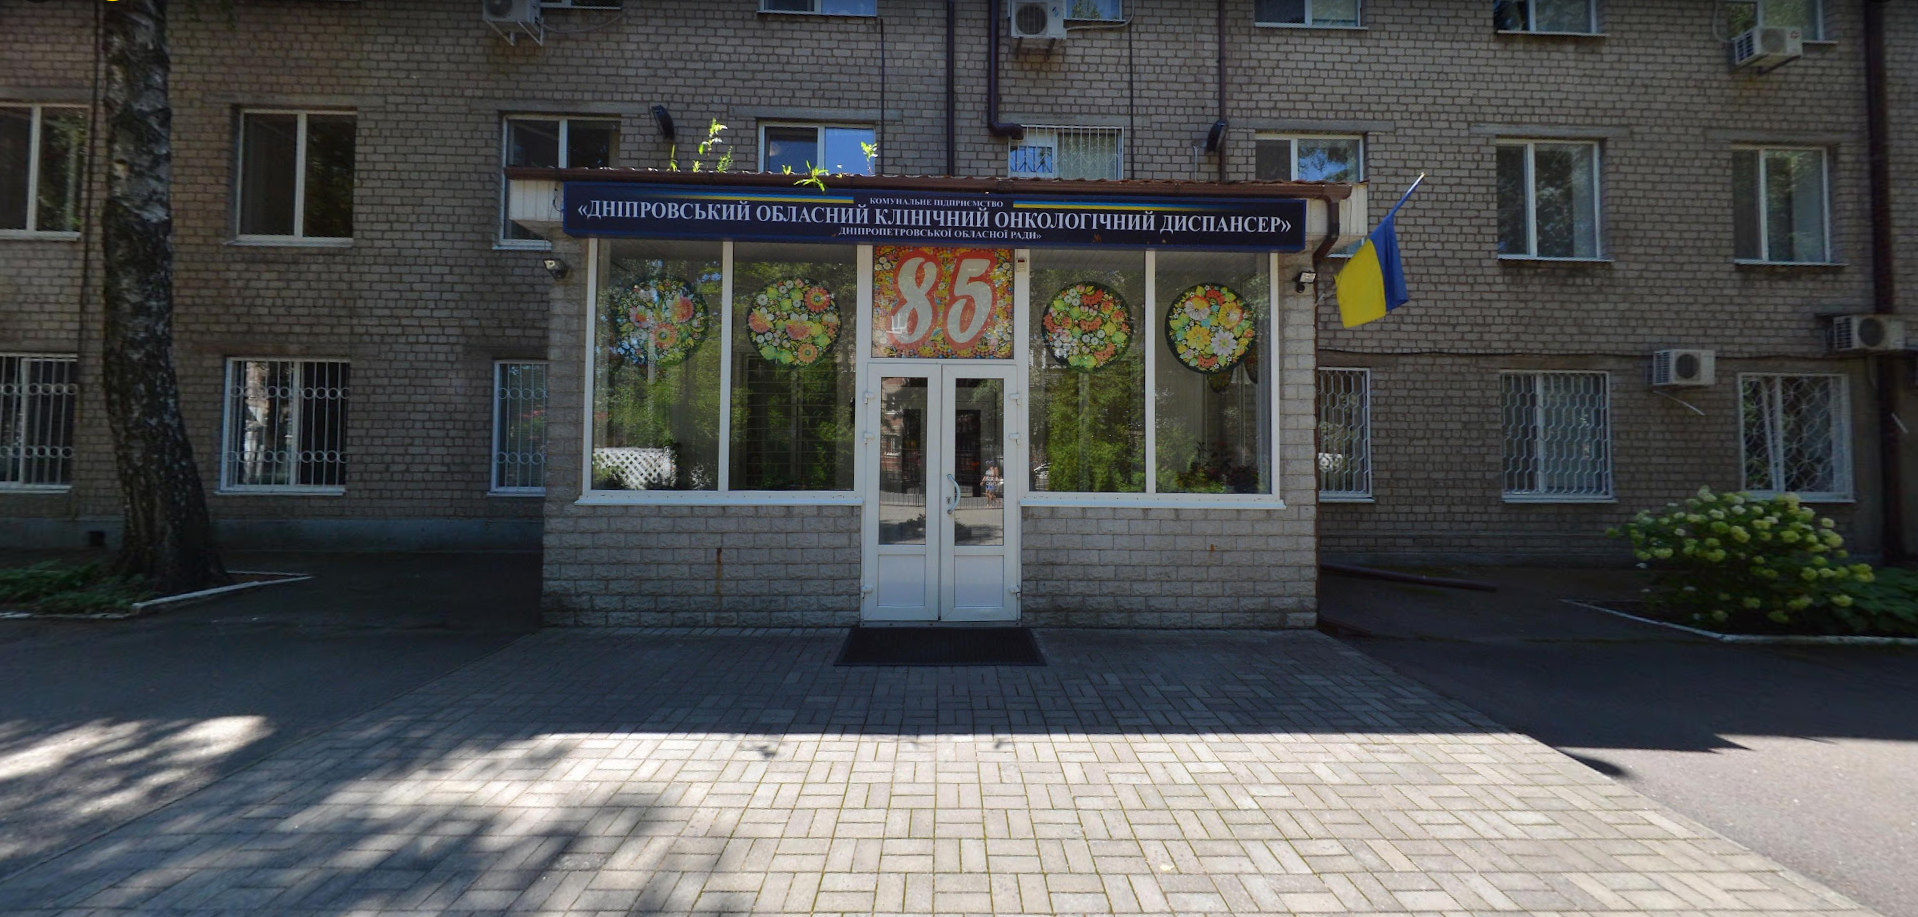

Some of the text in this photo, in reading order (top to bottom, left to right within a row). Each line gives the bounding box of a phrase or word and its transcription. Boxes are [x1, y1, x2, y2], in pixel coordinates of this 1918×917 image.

[870, 197, 1004, 208] КОМУНАЛЬНЕ ПІДПРИЄМСТВО
[577, 200, 1292, 235] «ДНІПРОВСЬКИЙ ОБЛАСНИЙ КЛІНІЧНИЙ ОНКОЛОГІЧНИЙ ДИСПАНСЕР»
[839, 227, 1042, 240] ДНІПРОПЕТРОВСЬКОЇ ОБЛАСНОЇ РАДИ»
[890, 253, 996, 346] 85
